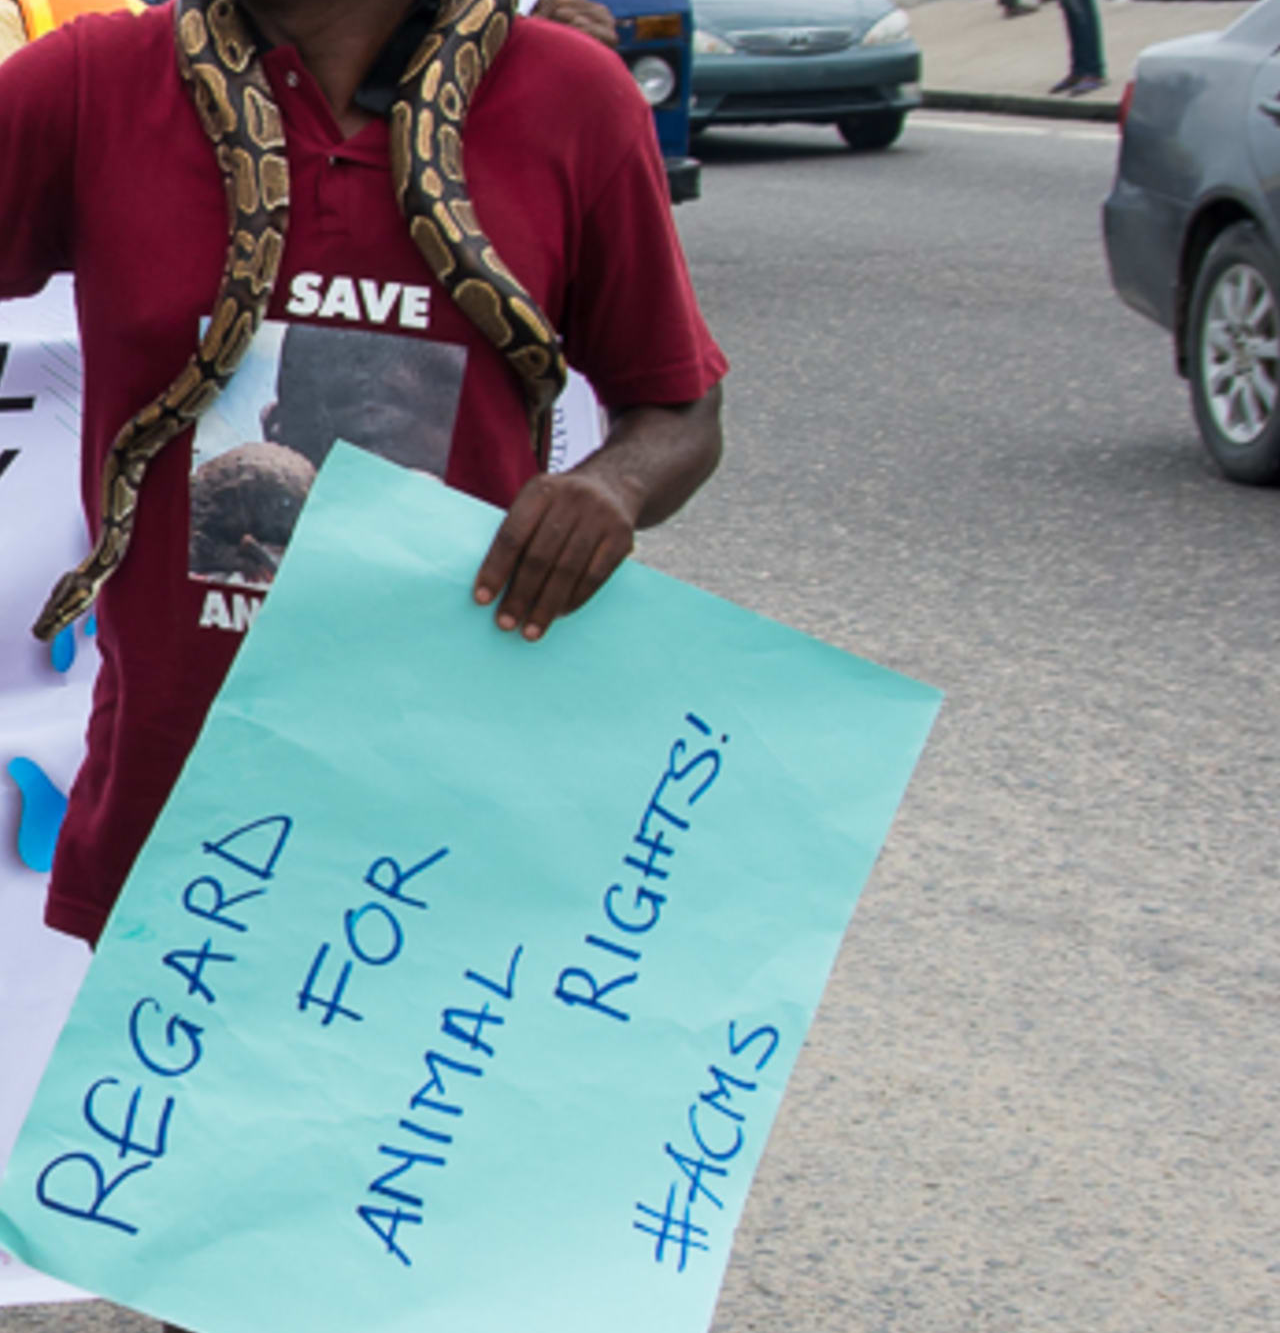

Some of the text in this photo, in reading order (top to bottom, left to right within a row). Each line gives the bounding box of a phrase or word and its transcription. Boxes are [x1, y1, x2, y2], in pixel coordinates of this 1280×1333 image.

[285, 271, 432, 330] SAVE
[295, 845, 453, 1027] FOR
[552, 709, 734, 1023] RIGHTS!
[34, 814, 294, 1236] REGARD
[354, 942, 526, 1267] ANIMAL
[632, 1017, 782, 1274] #ACMS
